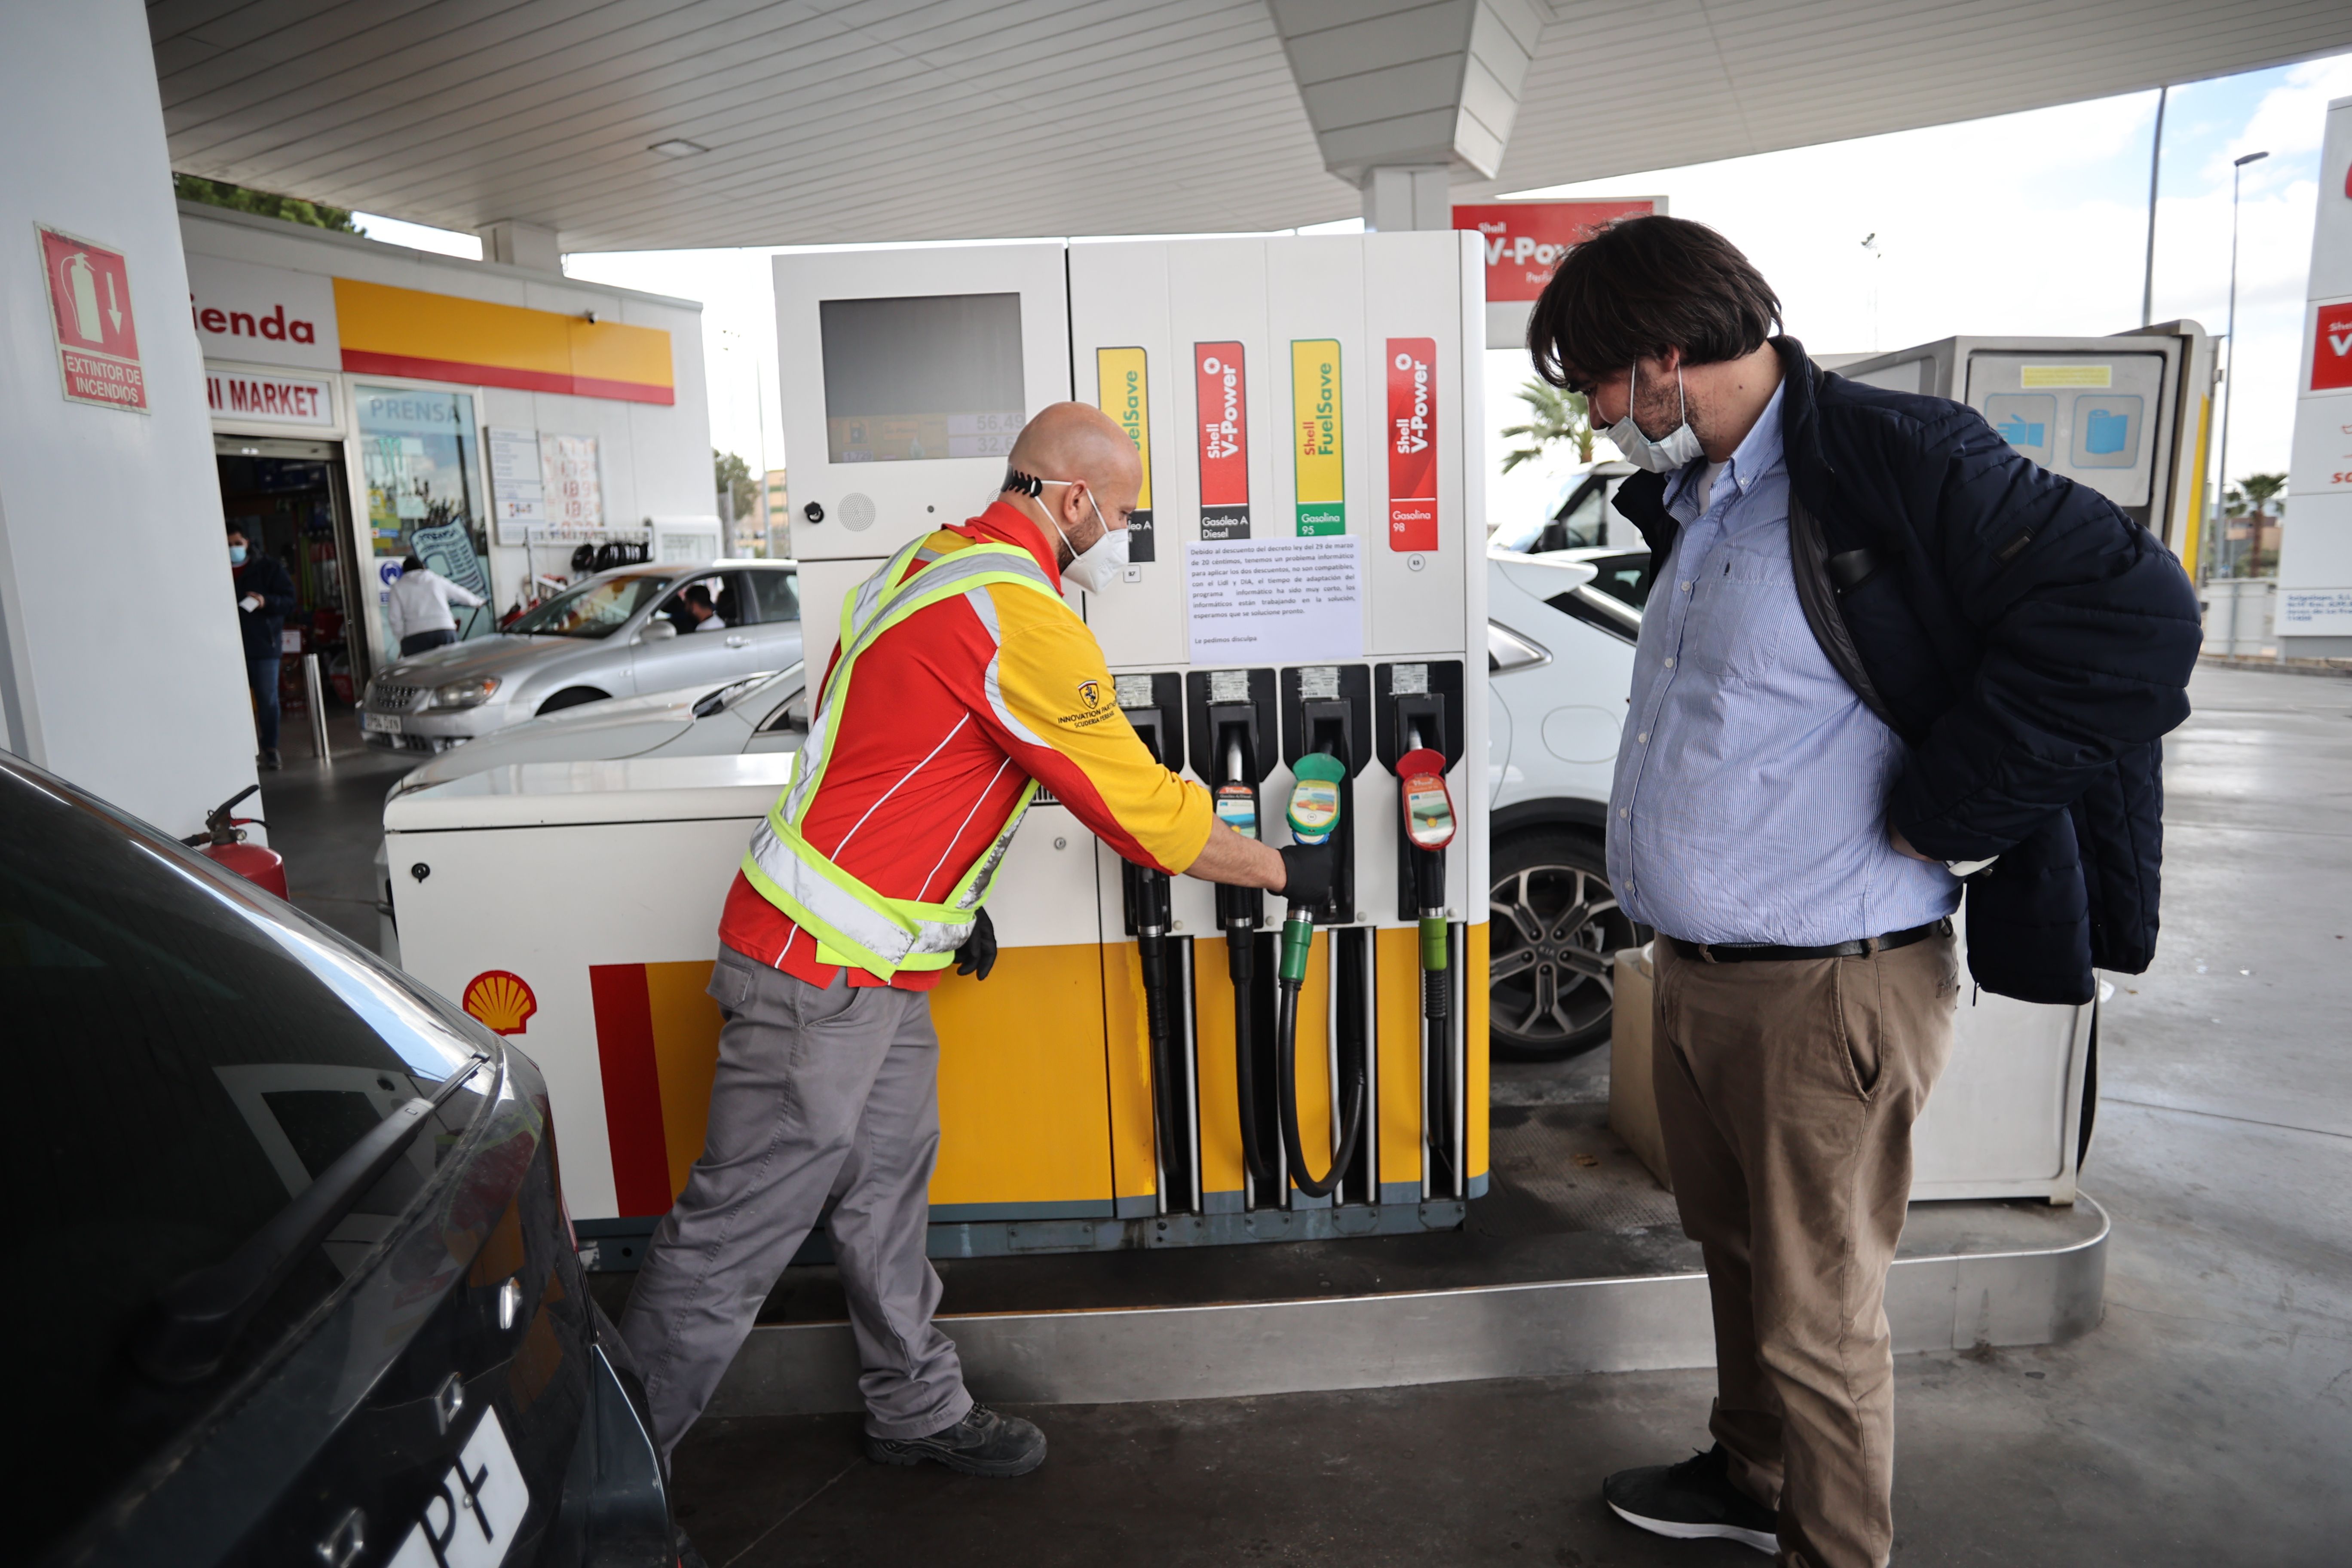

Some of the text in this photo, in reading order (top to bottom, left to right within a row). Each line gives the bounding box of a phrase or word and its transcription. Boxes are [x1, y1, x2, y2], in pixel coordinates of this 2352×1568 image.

[190, 294, 315, 345] ienda
[66, 355, 124, 382] EXTINTOR
[126, 368, 141, 385] DE
[76, 377, 138, 403] INCENDIOS
[207, 377, 318, 416] NI MARKET
[371, 398, 460, 423] PRENSA
[1122, 370, 1140, 451] elSave
[1220, 364, 1239, 458] V-Power
[1316, 363, 1334, 455] FuelSave
[1410, 360, 1428, 454] V-Power
[977, 437, 1013, 453] 32,6
[1206, 423, 1220, 459] Shell
[1303, 421, 1315, 455] Shell
[1396, 418, 1410, 454] Shell
[1128, 520, 1152, 530] leo A
[1202, 515, 1248, 527] Gasóleo A
[1301, 512, 1340, 523] Gasolina
[1392, 509, 1431, 520] Gasolina
[1203, 527, 1228, 538] Diesel
[1302, 526, 1314, 535] 95
[1393, 523, 1406, 533] 98
[1058, 708, 1101, 723] INNOVATION
[1075, 717, 1099, 728] SCUDERIA
